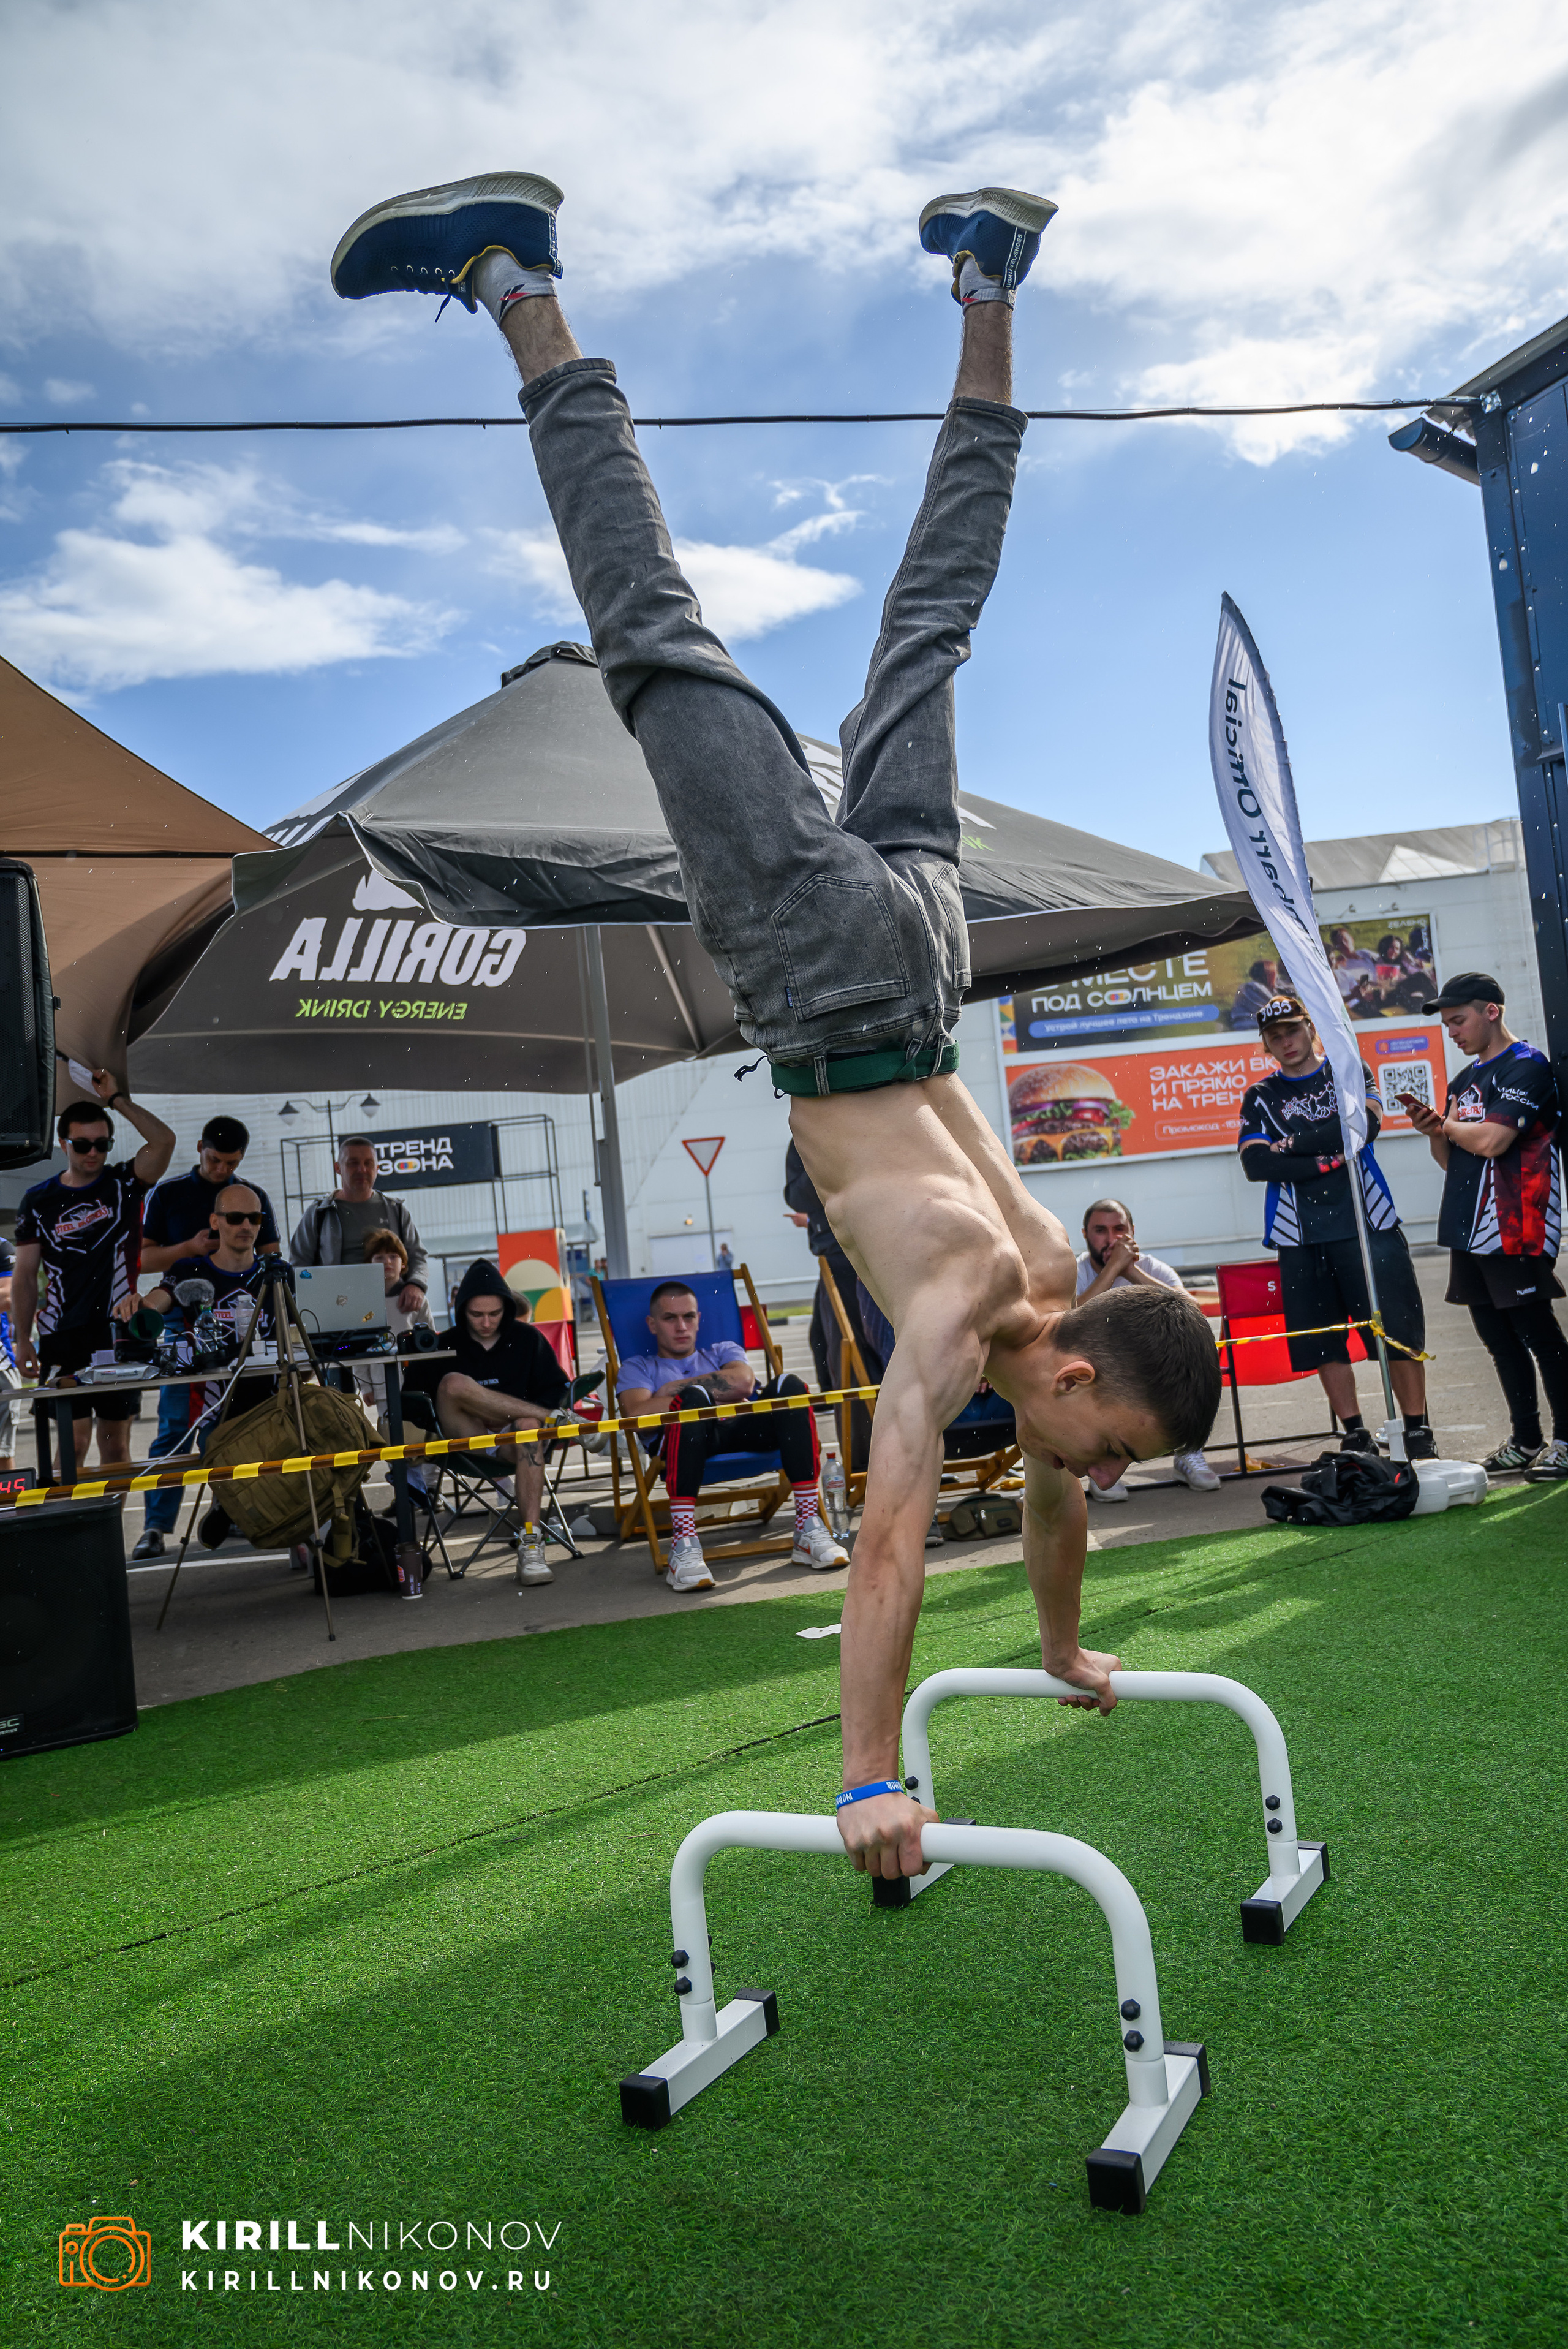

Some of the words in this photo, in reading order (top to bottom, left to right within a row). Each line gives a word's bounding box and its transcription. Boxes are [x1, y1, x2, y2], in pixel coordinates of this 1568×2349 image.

[1031, 993, 1082, 1013] ПОД
[1087, 981, 1212, 1008] СОЛНЦЕМ
[1149, 1059, 1245, 1081] ЗАКАЖИ
[1250, 1057, 1278, 1072] ВК
[1151, 1081, 1167, 1096] И
[1172, 1074, 1247, 1094] ПРЯМО
[1152, 1096, 1183, 1112] НА
[1187, 1091, 1243, 1108] ТРЕН
[1163, 1122, 1220, 1135] Промокод
[374, 1137, 453, 1159] ТРЕНД
[377, 1154, 454, 1176] ЗОНА
